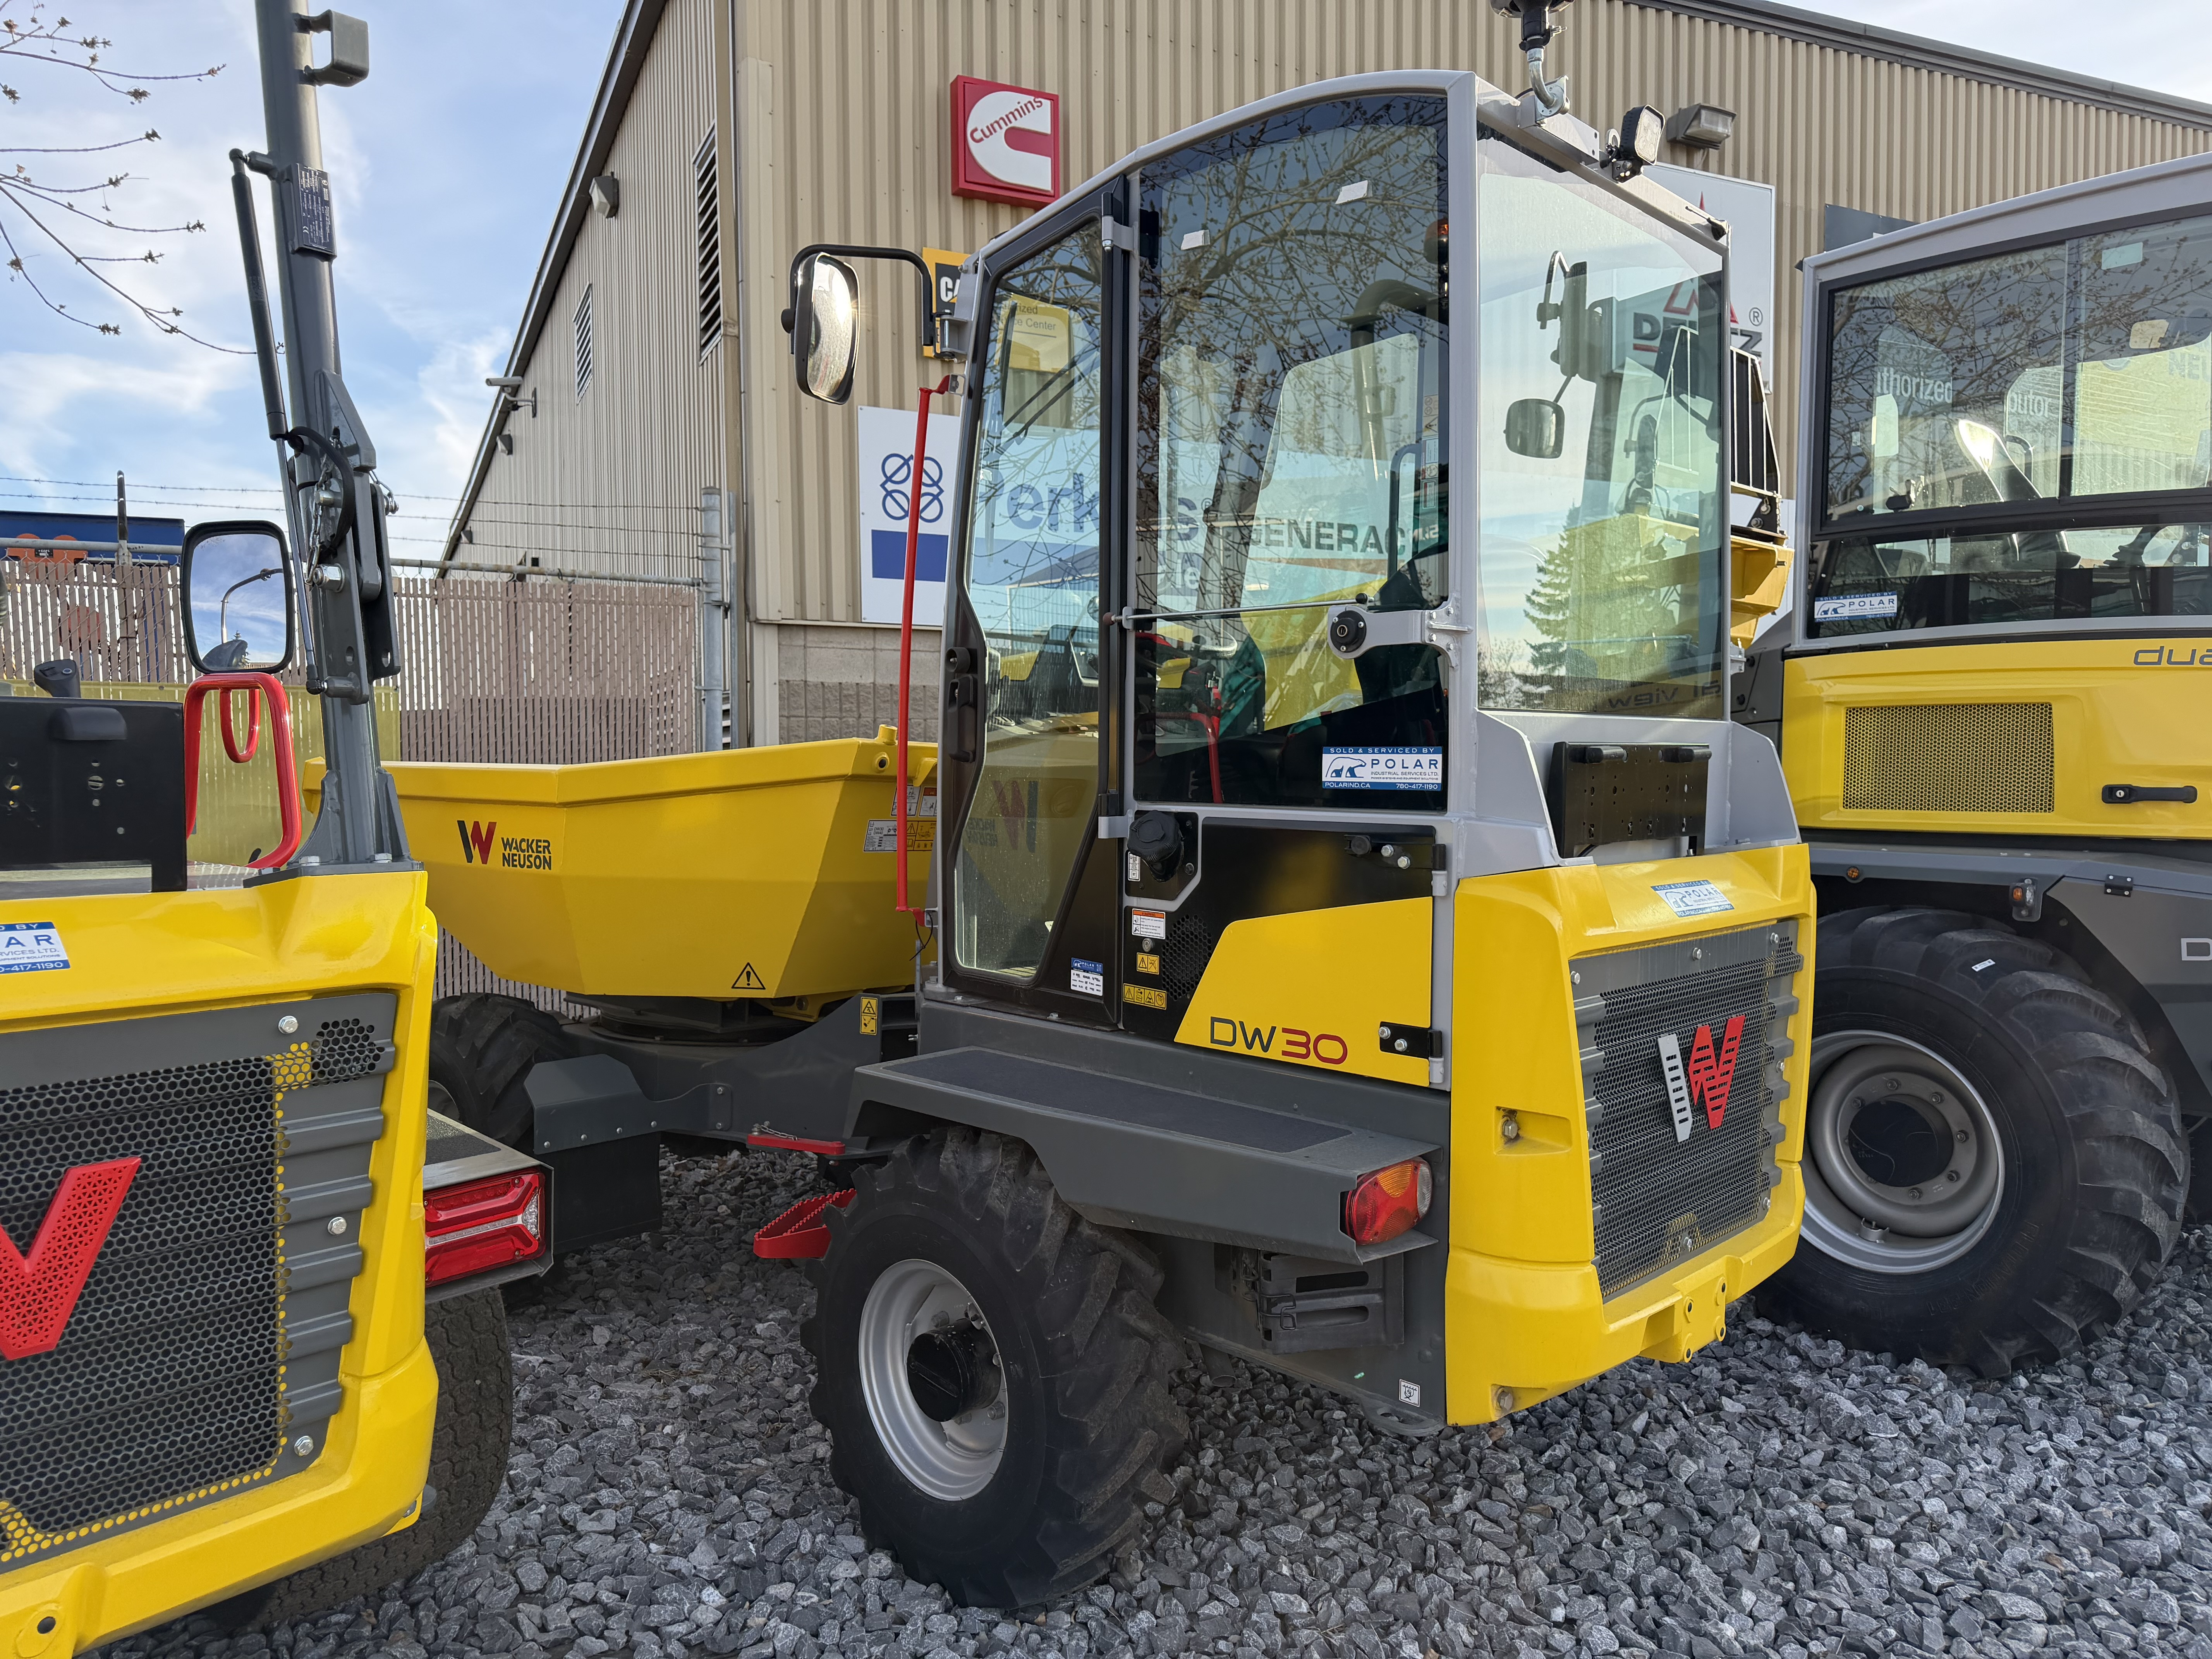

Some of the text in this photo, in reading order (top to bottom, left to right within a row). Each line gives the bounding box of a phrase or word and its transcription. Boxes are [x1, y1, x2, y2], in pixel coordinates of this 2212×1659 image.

[970, 97, 1043, 143] Cummins
[1026, 318, 1056, 330] Center
[1849, 599, 1894, 608] POLAR
[1371, 759, 1438, 769] POLAR
[501, 837, 551, 854] WACKER
[502, 853, 551, 870] NEUSON
[1685, 888, 1721, 898] POLAR
[1210, 1016, 1348, 1065] DW30
